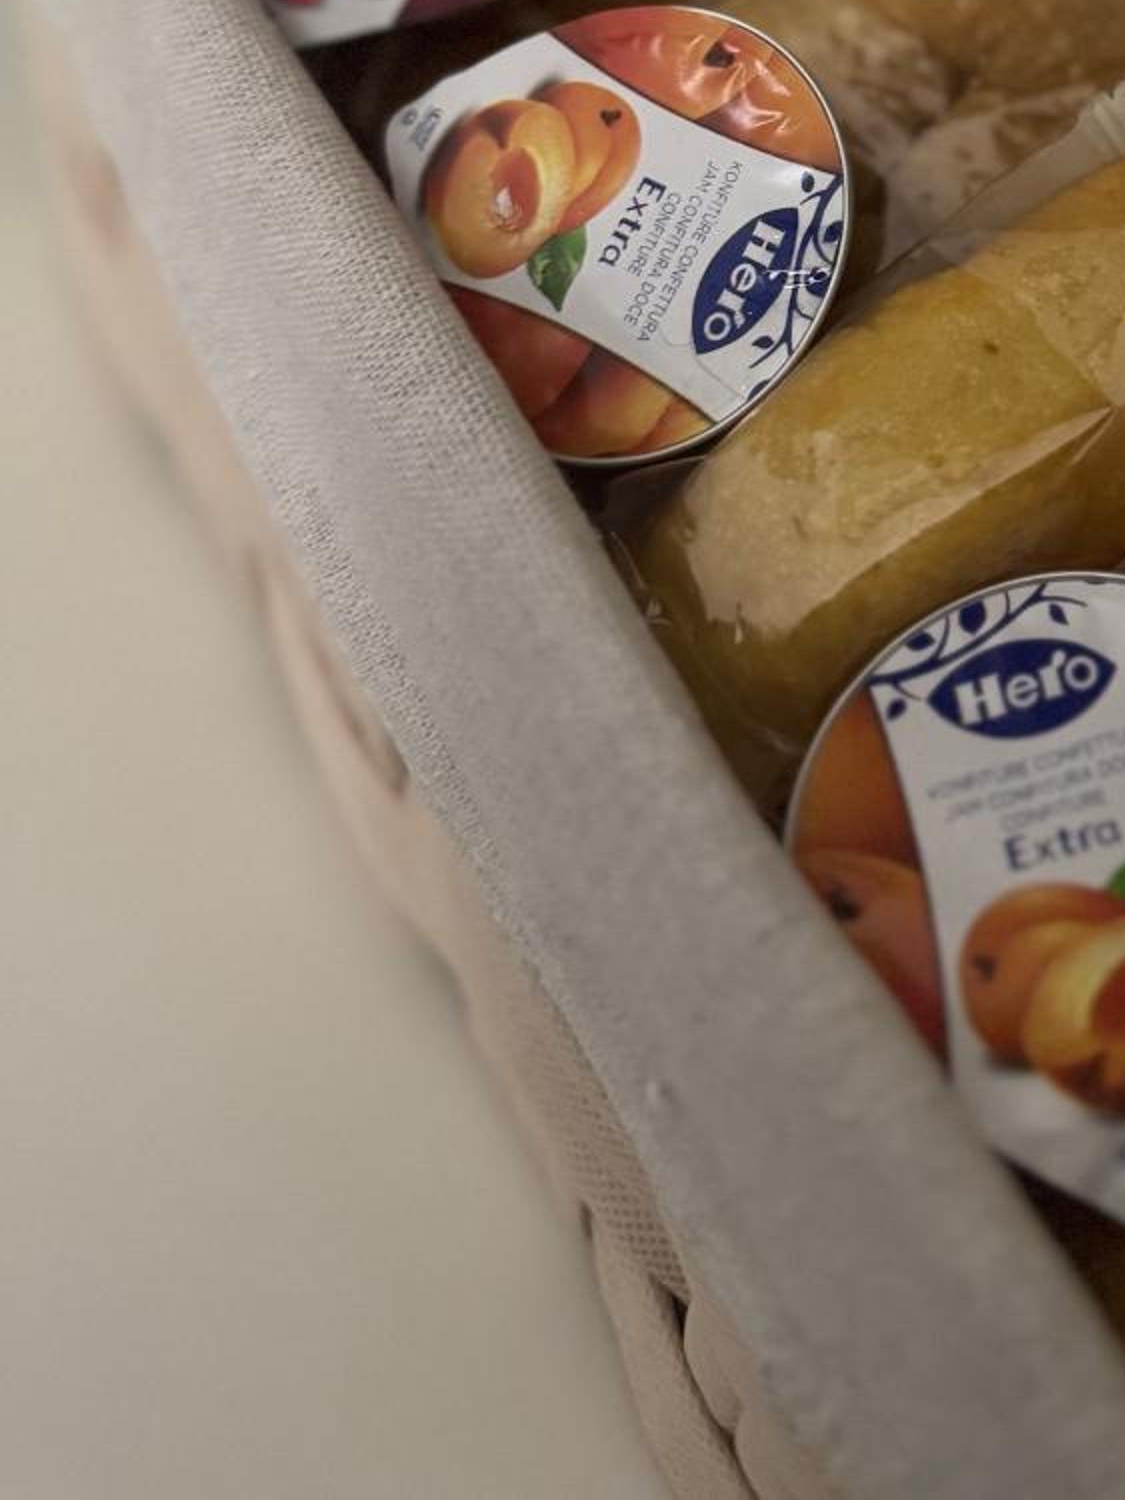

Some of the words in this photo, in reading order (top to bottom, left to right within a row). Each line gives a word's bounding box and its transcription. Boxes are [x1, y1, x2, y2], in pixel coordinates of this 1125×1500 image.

[597, 176, 667, 267] Extra
[628, 192, 681, 277] CONFITURE
[650, 194, 703, 279] CONFITURA
[624, 281, 655, 327] DOCE
[637, 245, 699, 342] CONFETTURA
[703, 220, 785, 341] Hero
[954, 649, 1098, 726] Hero
[1003, 819, 1122, 872] Extra
